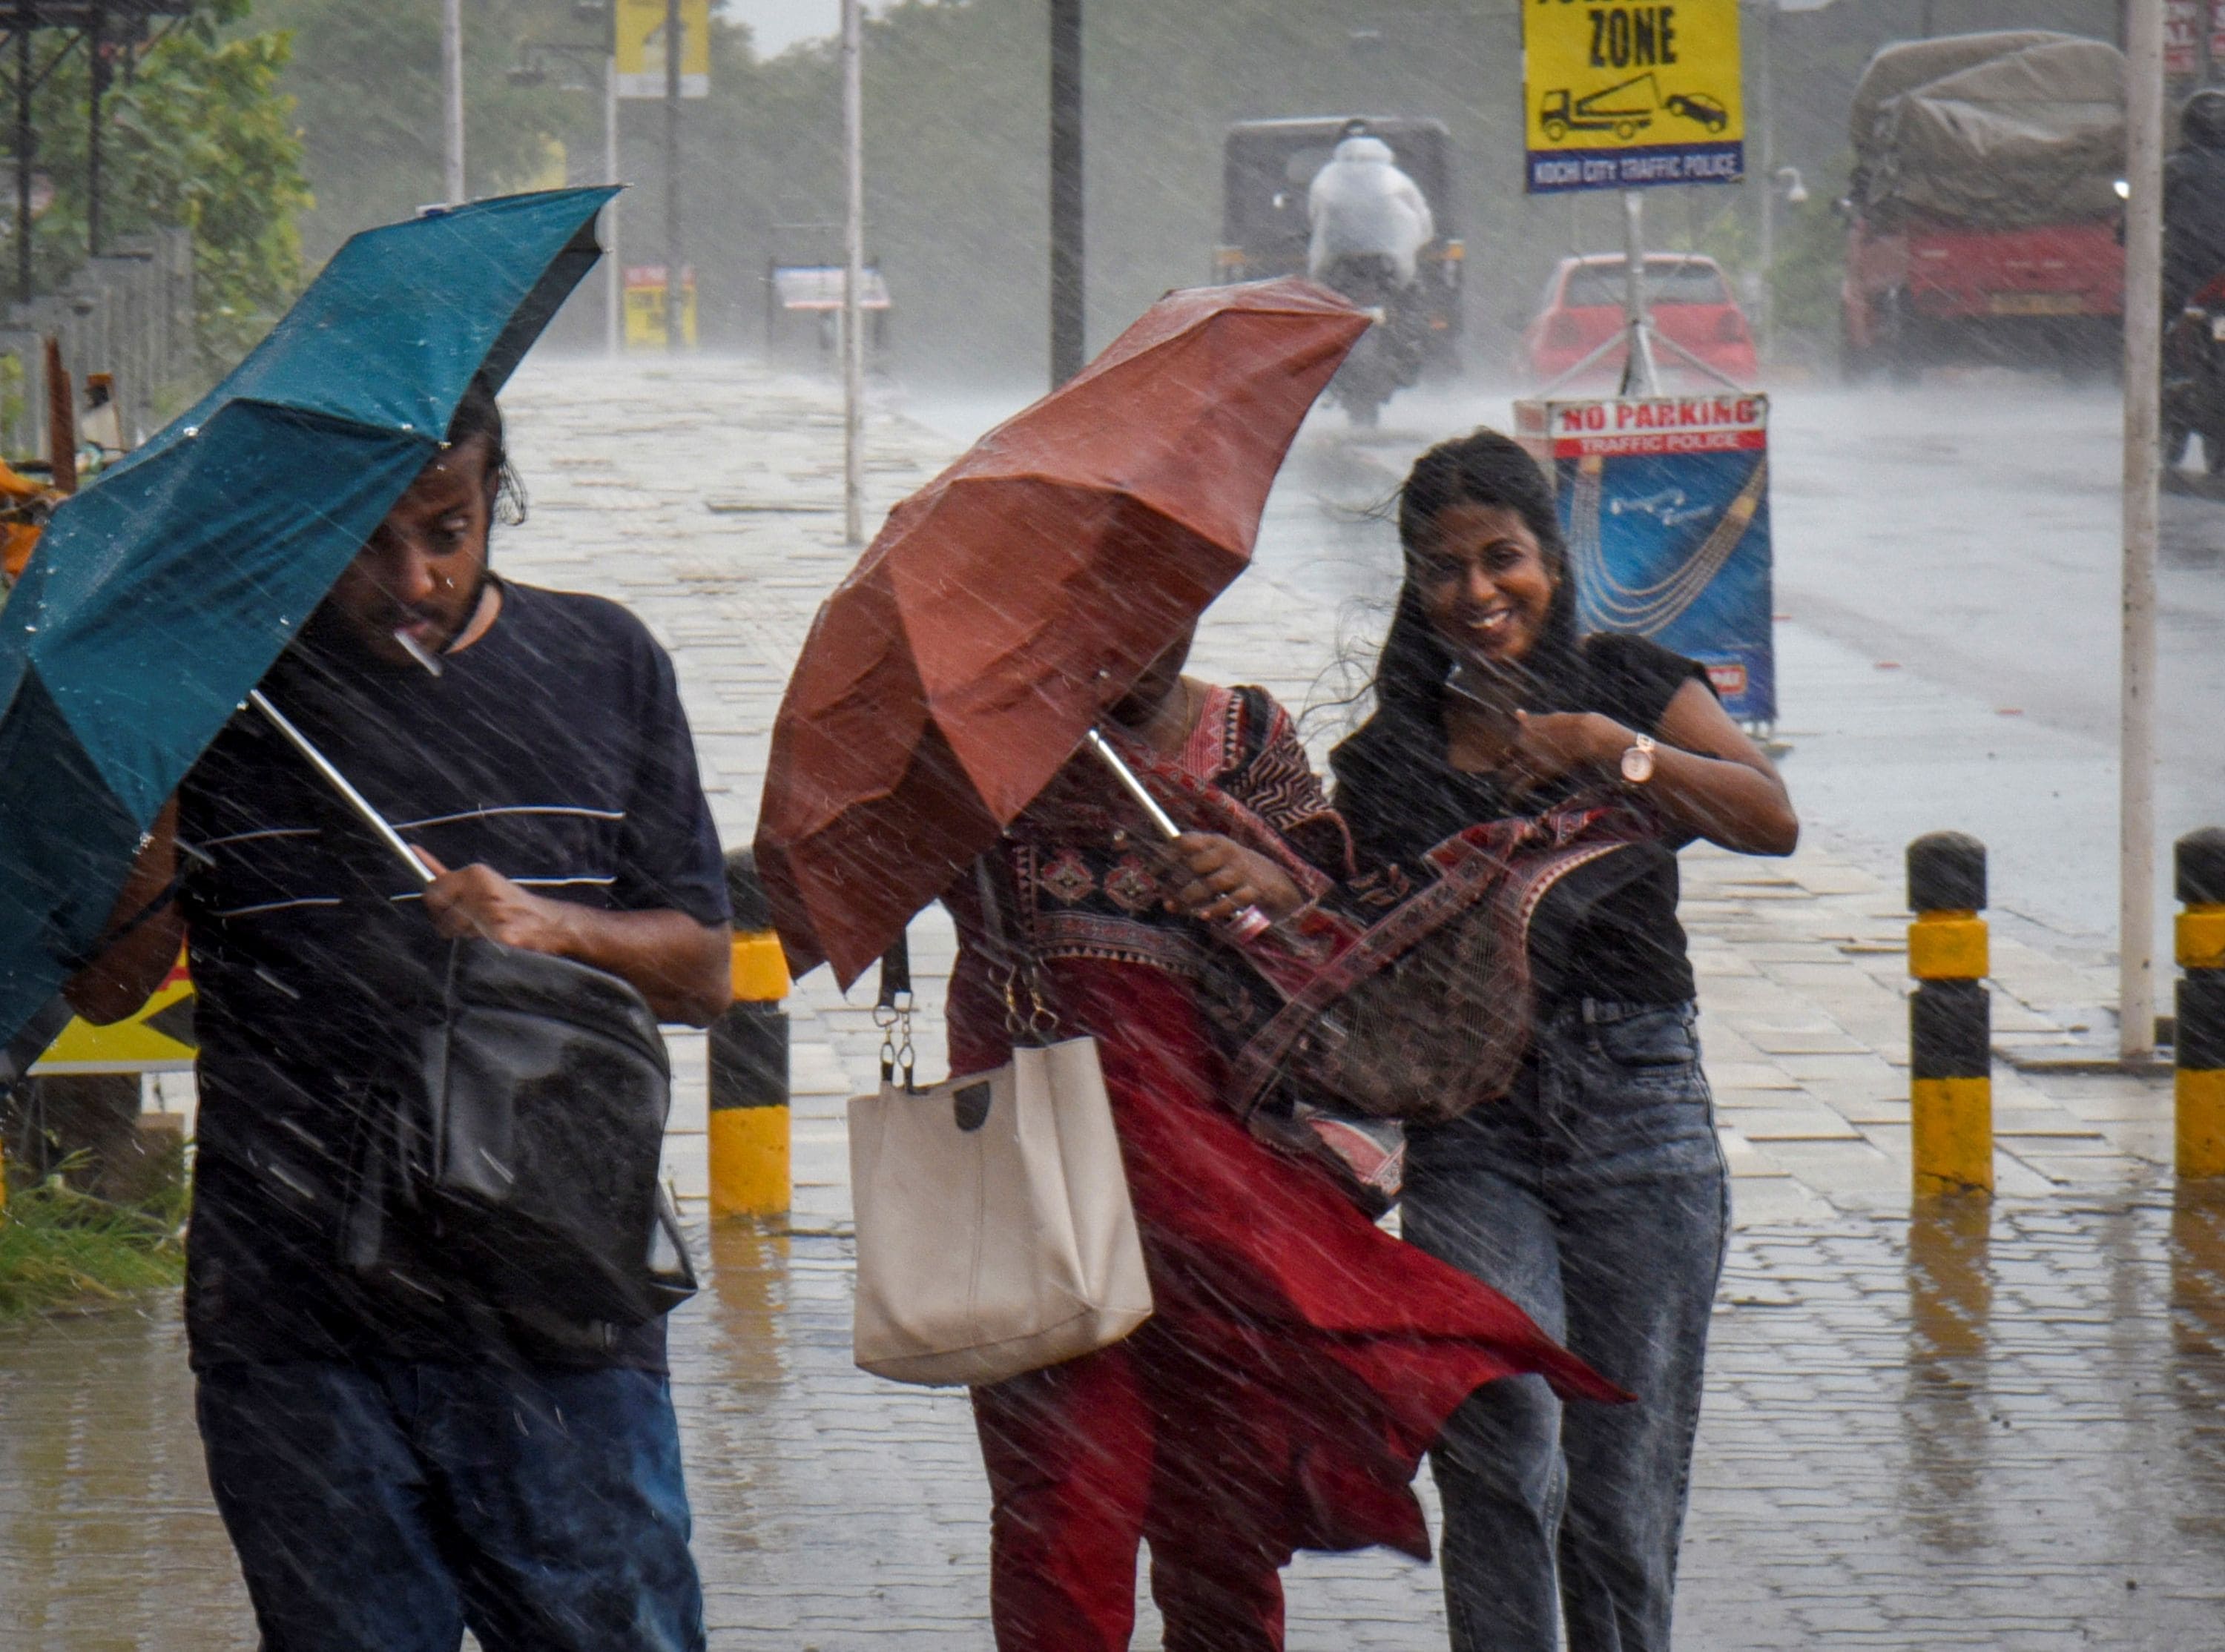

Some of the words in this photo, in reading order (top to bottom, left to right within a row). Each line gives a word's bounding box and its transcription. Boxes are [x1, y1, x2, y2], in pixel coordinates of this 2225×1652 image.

[1590, 7, 1677, 67] ZONE
[1535, 161, 1581, 183] KOCHI
[1583, 159, 1617, 180] CITY
[1620, 156, 1681, 179] TRAFFIC
[1684, 153, 1737, 177] POLICE
[1563, 406, 1606, 432] NO
[1617, 400, 1757, 429] PARKING
[1580, 435, 1662, 454] TRAFFIC
[1667, 432, 1738, 450] POLICE
